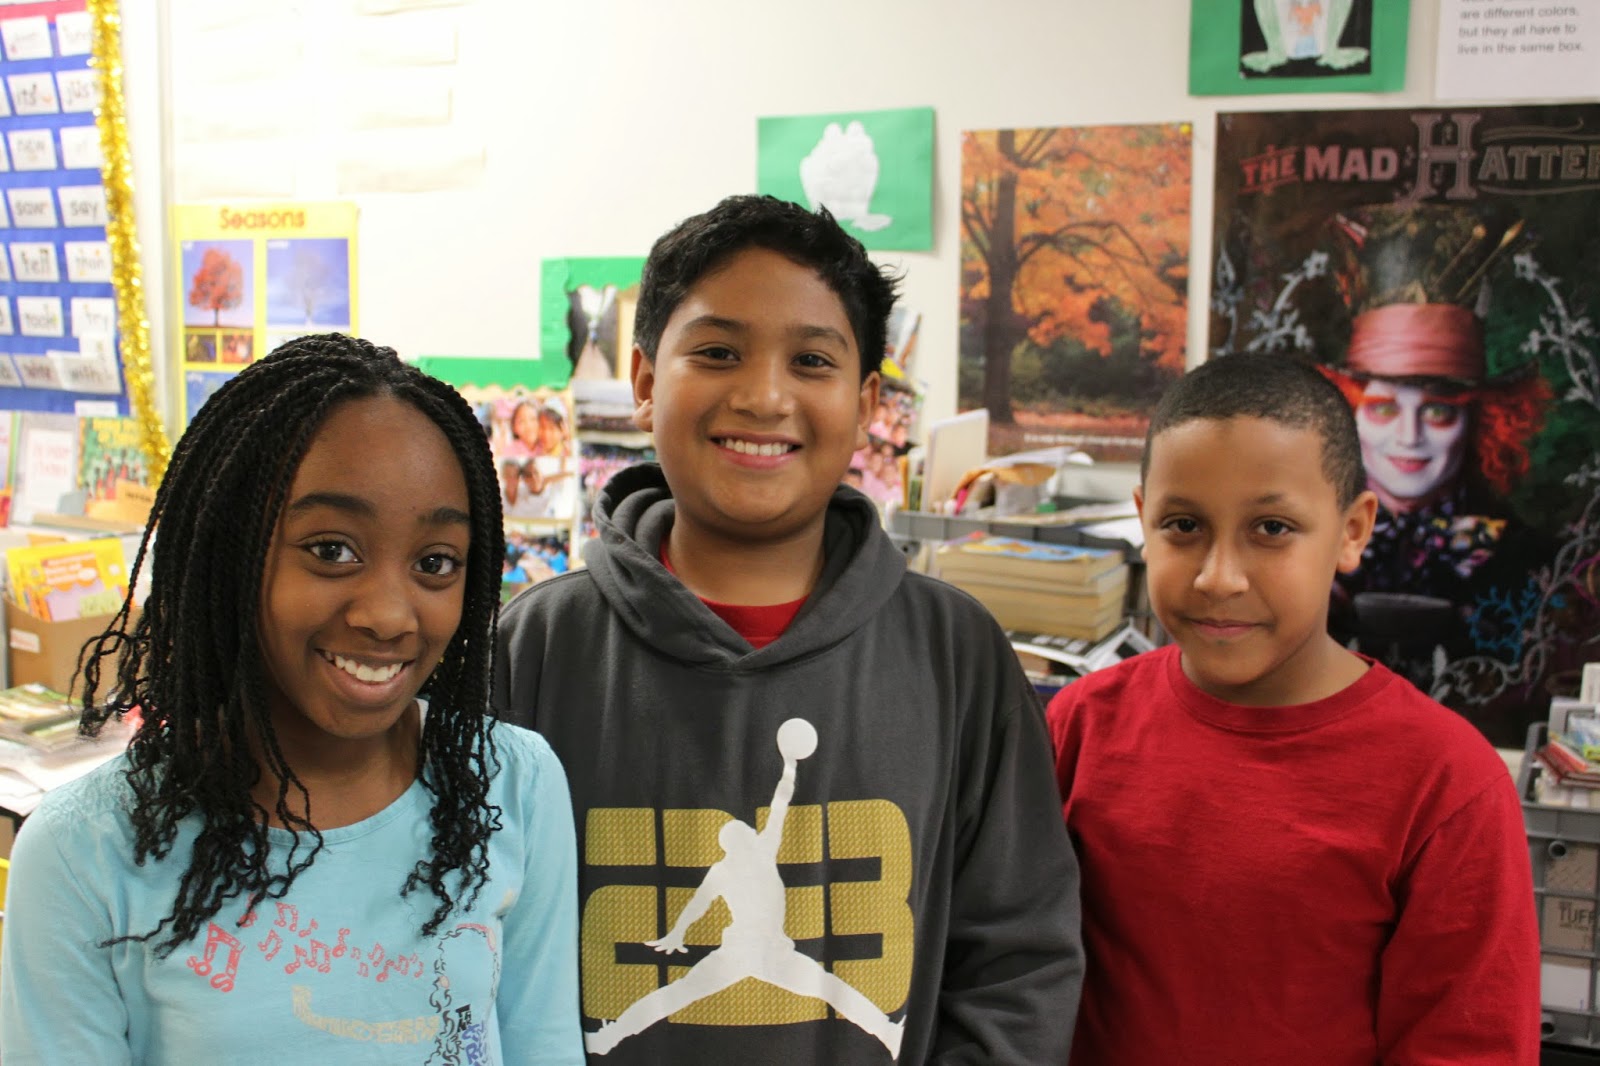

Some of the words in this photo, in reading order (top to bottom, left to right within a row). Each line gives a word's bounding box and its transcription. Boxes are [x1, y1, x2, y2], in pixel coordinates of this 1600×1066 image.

[1460, 9, 1480, 19] are
[1484, 8, 1534, 19] different
[1459, 27, 1478, 38] but
[1482, 26, 1508, 37] they
[1512, 25, 1526, 36] all
[1530, 24, 1560, 34] have
[1565, 23, 1576, 33] to
[1458, 44, 1478, 54] live
[1482, 44, 1493, 53] in
[1497, 43, 1516, 53] the
[1520, 42, 1555, 52] same
[1241, 152, 1296, 187] THE
[1304, 145, 1399, 182] MAD
[219, 208, 305, 229] Seasons
[581, 799, 914, 1026] 23
